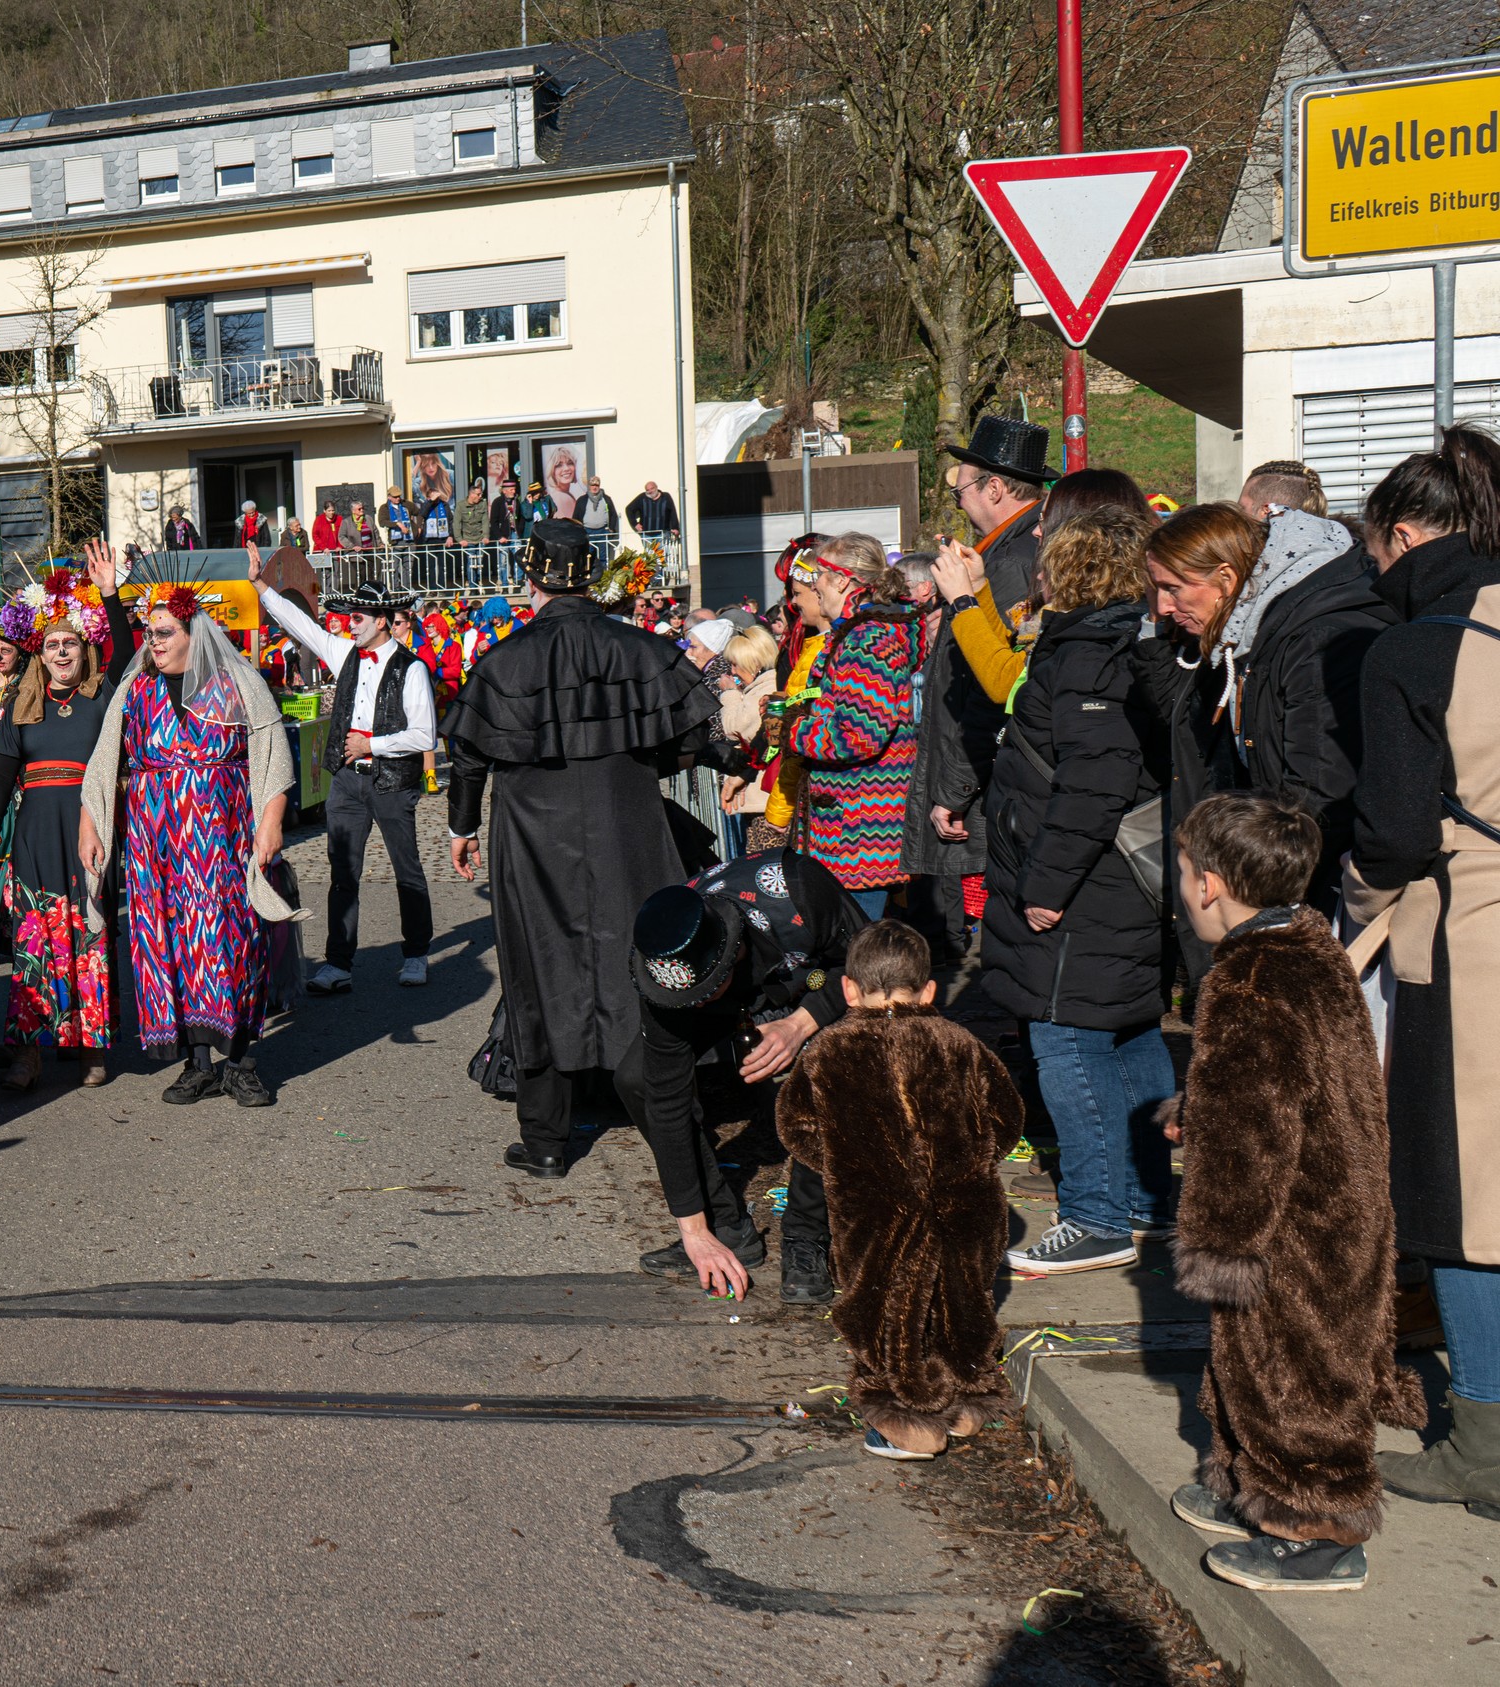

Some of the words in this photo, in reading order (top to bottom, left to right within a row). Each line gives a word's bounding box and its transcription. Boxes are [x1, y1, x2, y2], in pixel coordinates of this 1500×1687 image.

[1331, 110, 1498, 169] Wallend
[1330, 195, 1419, 222] Eifelkreis
[1430, 190, 1500, 212] Bitburg
[208, 606, 239, 620] CHS
